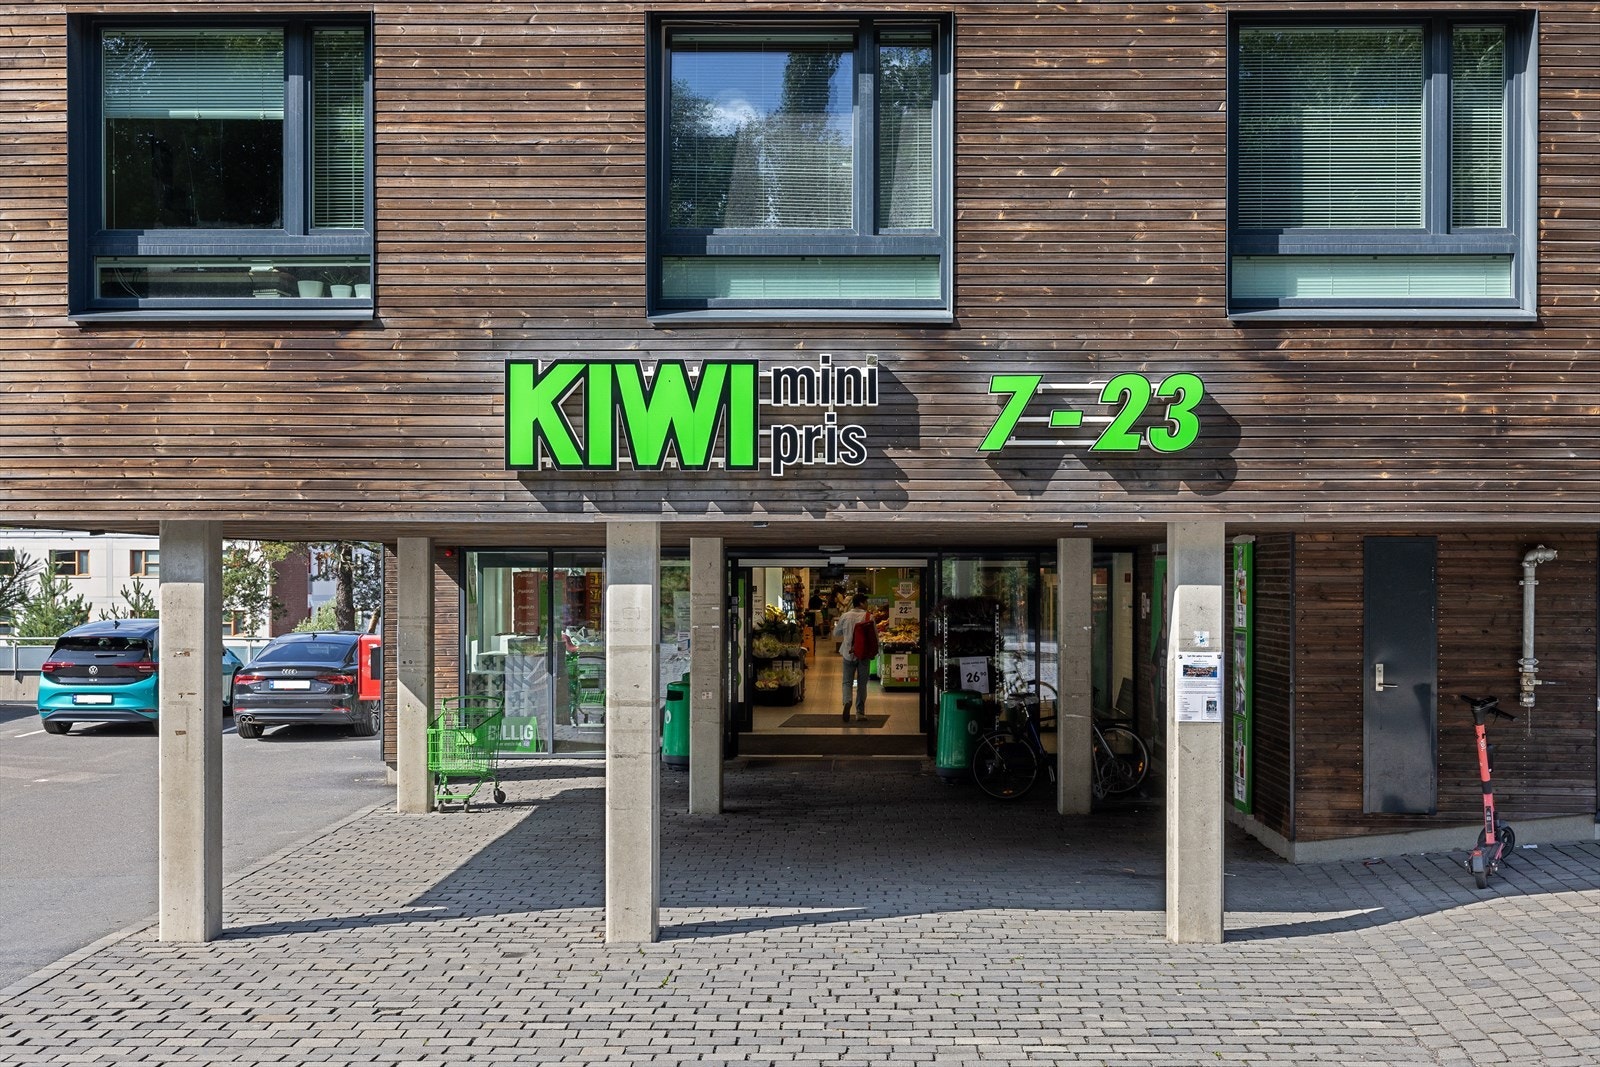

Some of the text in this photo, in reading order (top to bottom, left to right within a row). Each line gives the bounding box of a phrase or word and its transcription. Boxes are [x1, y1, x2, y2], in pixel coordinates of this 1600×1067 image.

[770, 354, 879, 407] mini
[506, 359, 757, 469] KIWI
[770, 412, 867, 476] pris
[899, 606, 908, 614] 22
[966, 671, 980, 683] 26
[487, 724, 534, 741] BILLIG
